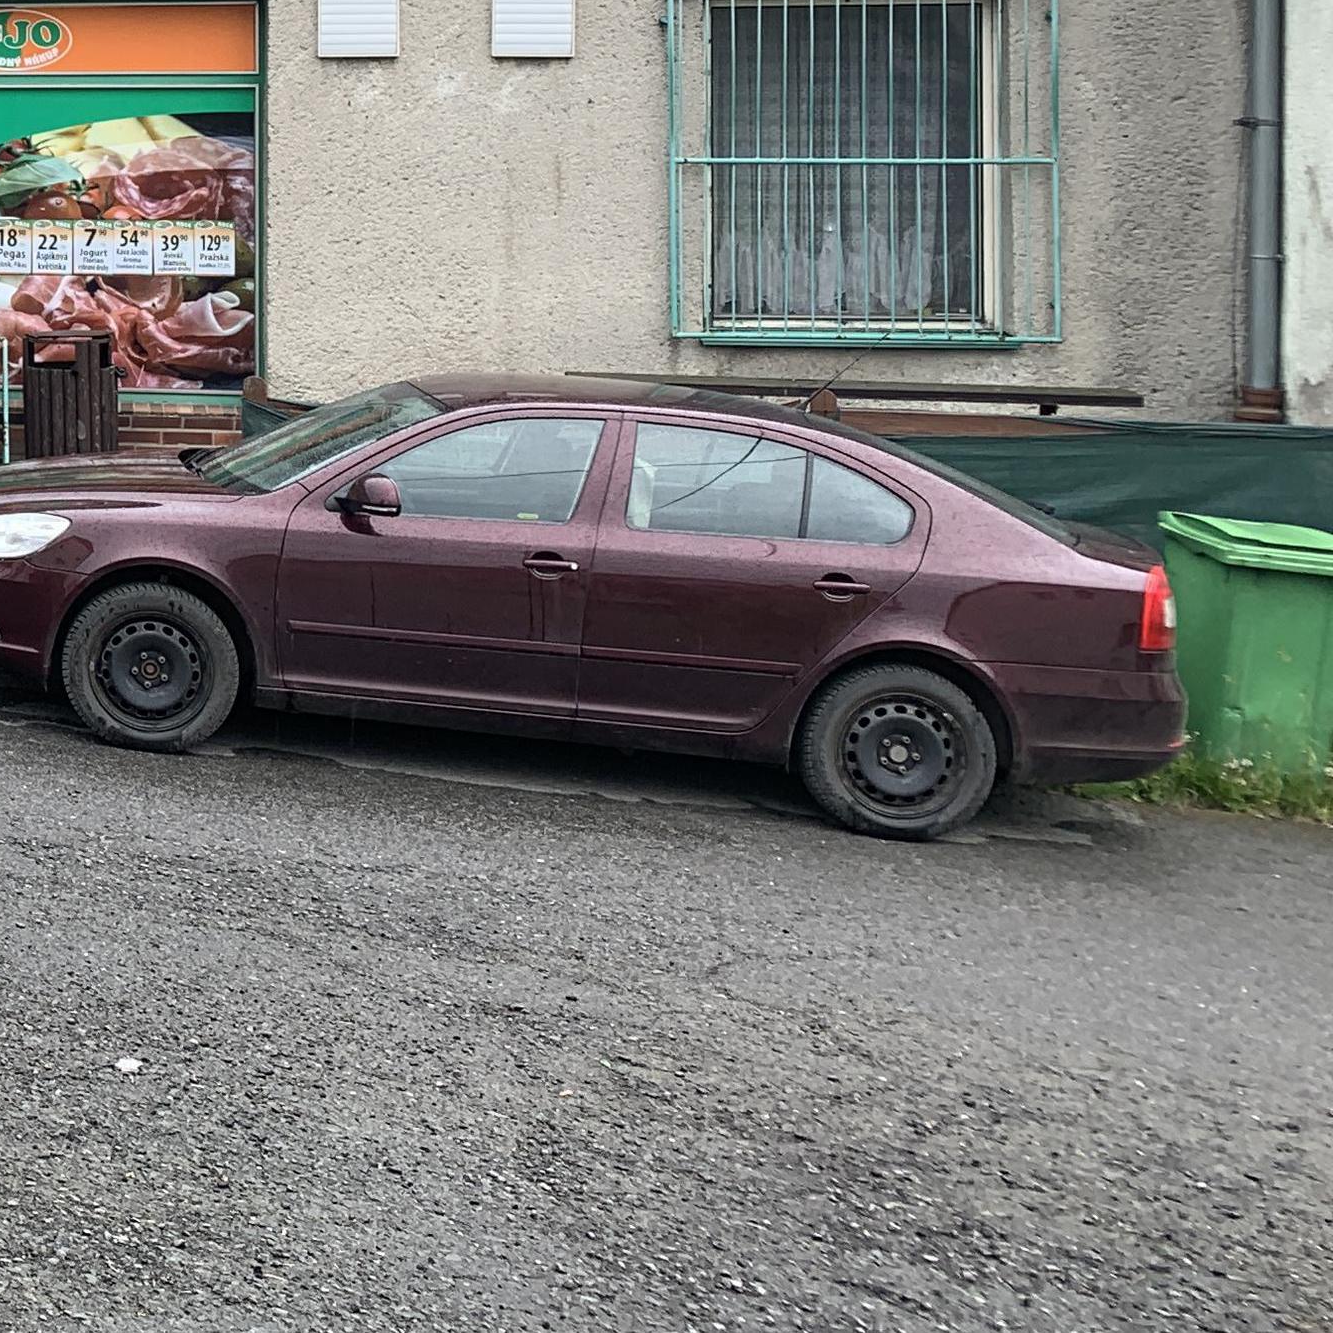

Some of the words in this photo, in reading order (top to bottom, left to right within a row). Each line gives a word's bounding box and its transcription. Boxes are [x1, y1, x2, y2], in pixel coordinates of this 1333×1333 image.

[4, 18, 62, 49] JO
[24, 47, 59, 66] NÁKUP
[38, 234, 58, 250] 22
[84, 228, 97, 246] 7
[120, 230, 139, 247] 54
[161, 235, 180, 251] 39
[200, 235, 221, 251] 129
[80, 248, 108, 257] Jogurt
